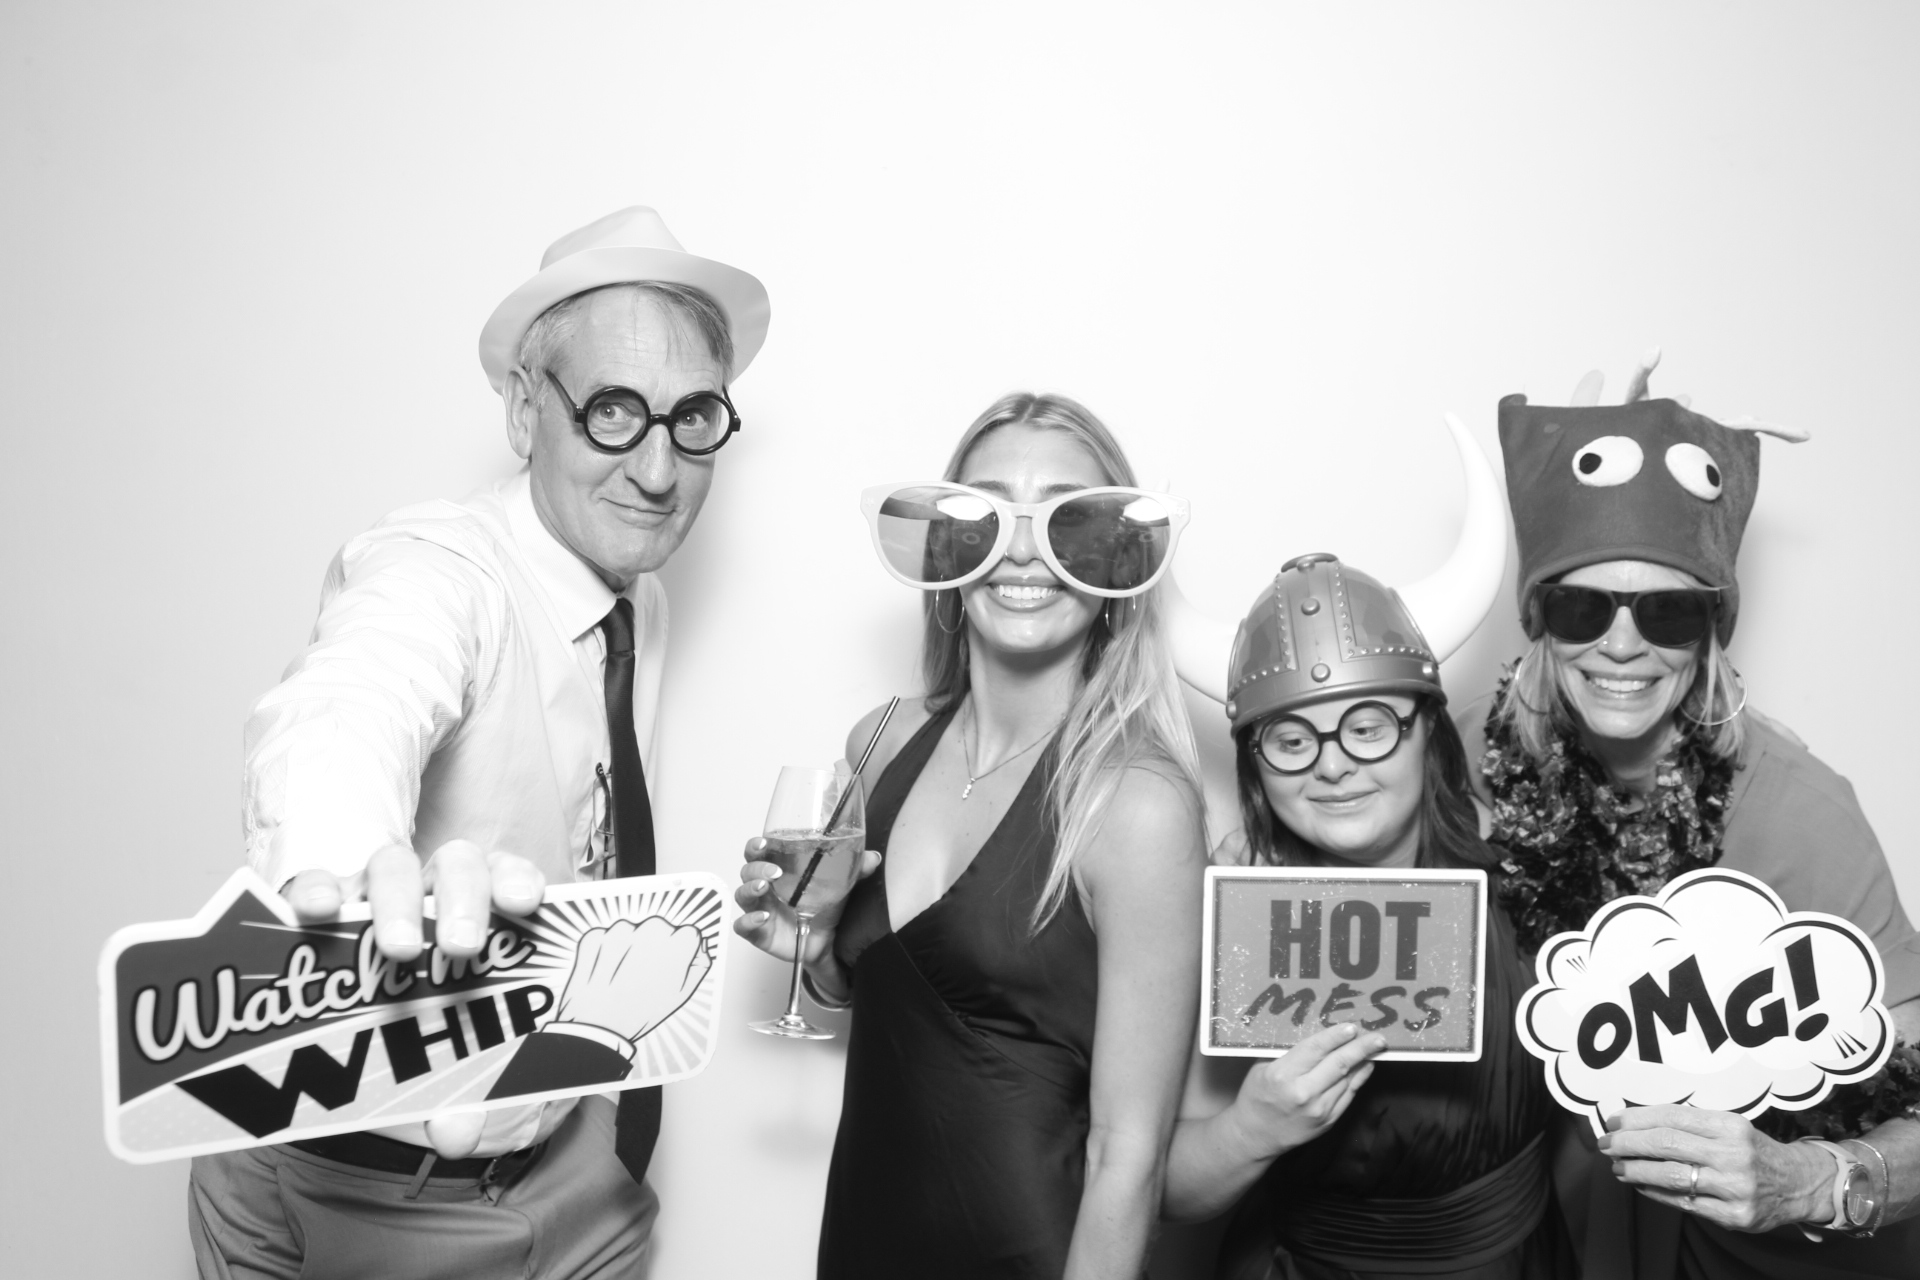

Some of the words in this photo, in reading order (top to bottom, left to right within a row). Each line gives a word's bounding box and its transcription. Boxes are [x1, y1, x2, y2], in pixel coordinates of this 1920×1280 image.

[132, 921, 415, 1063] Watch
[1241, 982, 1451, 1032] MESS
[1269, 900, 1431, 981] HOT
[1577, 933, 1829, 1070] OMG!
[174, 983, 555, 1139] WHIP
